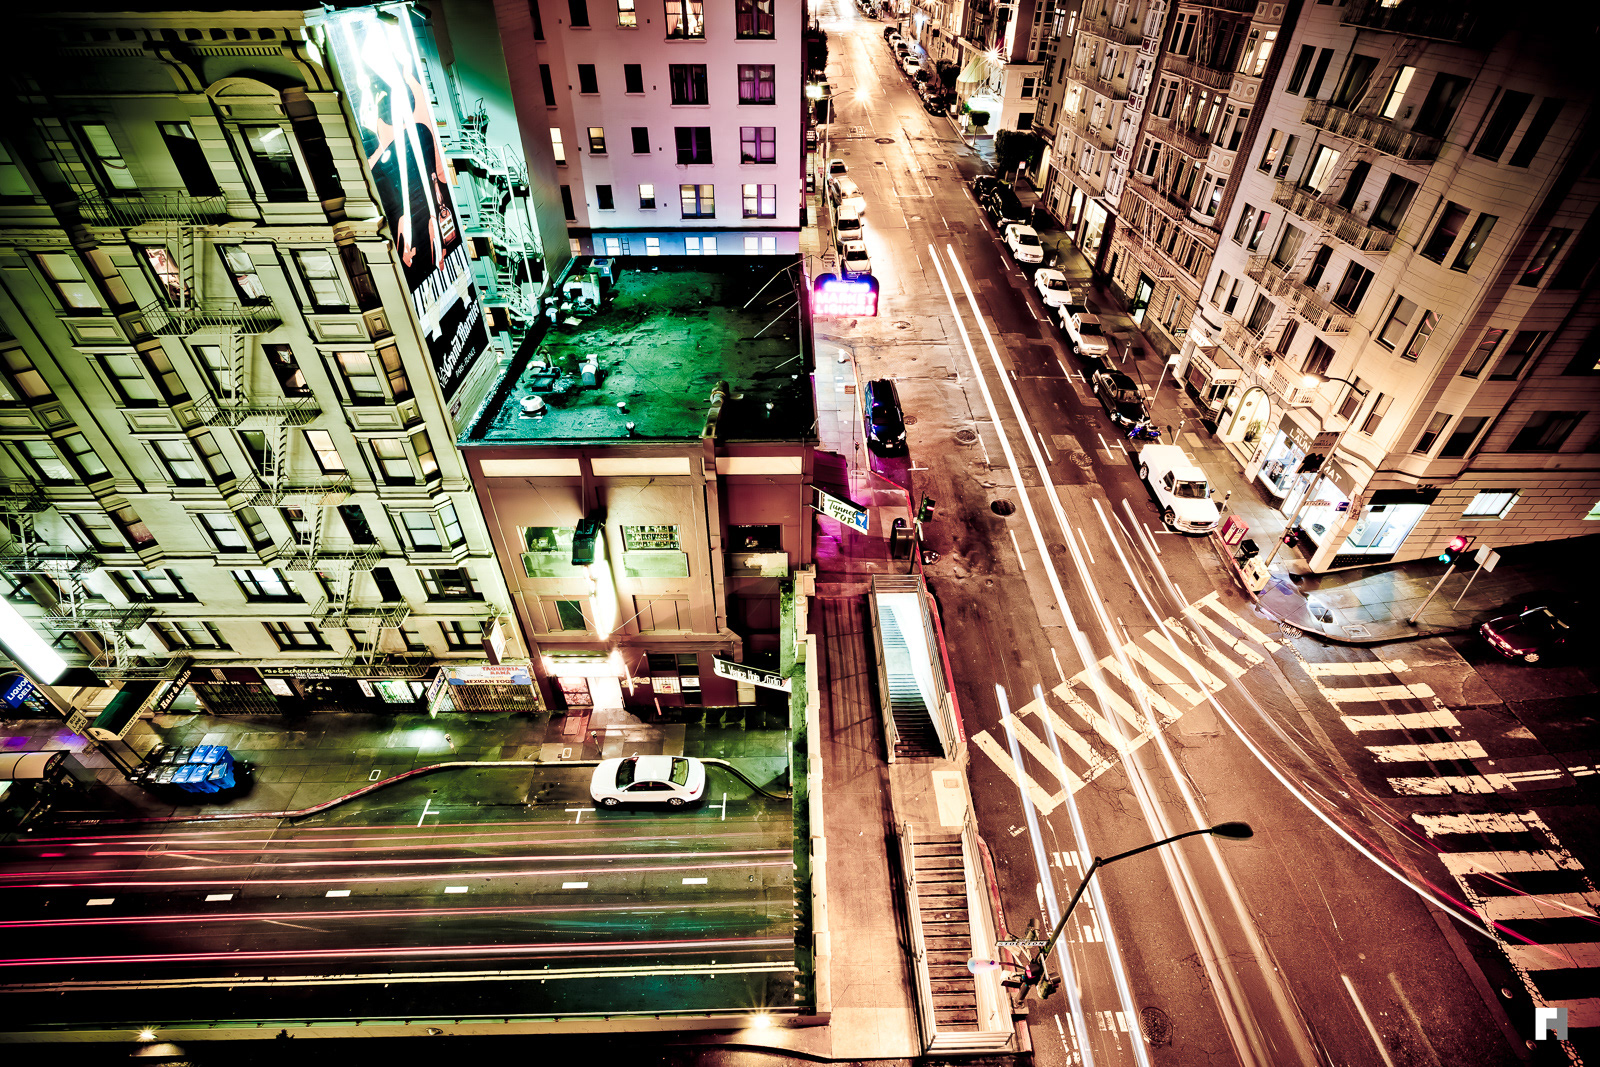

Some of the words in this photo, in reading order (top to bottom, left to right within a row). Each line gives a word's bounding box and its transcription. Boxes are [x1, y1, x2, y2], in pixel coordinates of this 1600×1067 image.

[816, 292, 876, 305] MARKET
[816, 304, 874, 315] LIQUORS
[16, 683, 33, 701] DELI
[160, 691, 175, 710] Hair
[172, 685, 180, 694] &
[176, 669, 192, 687] Nails
